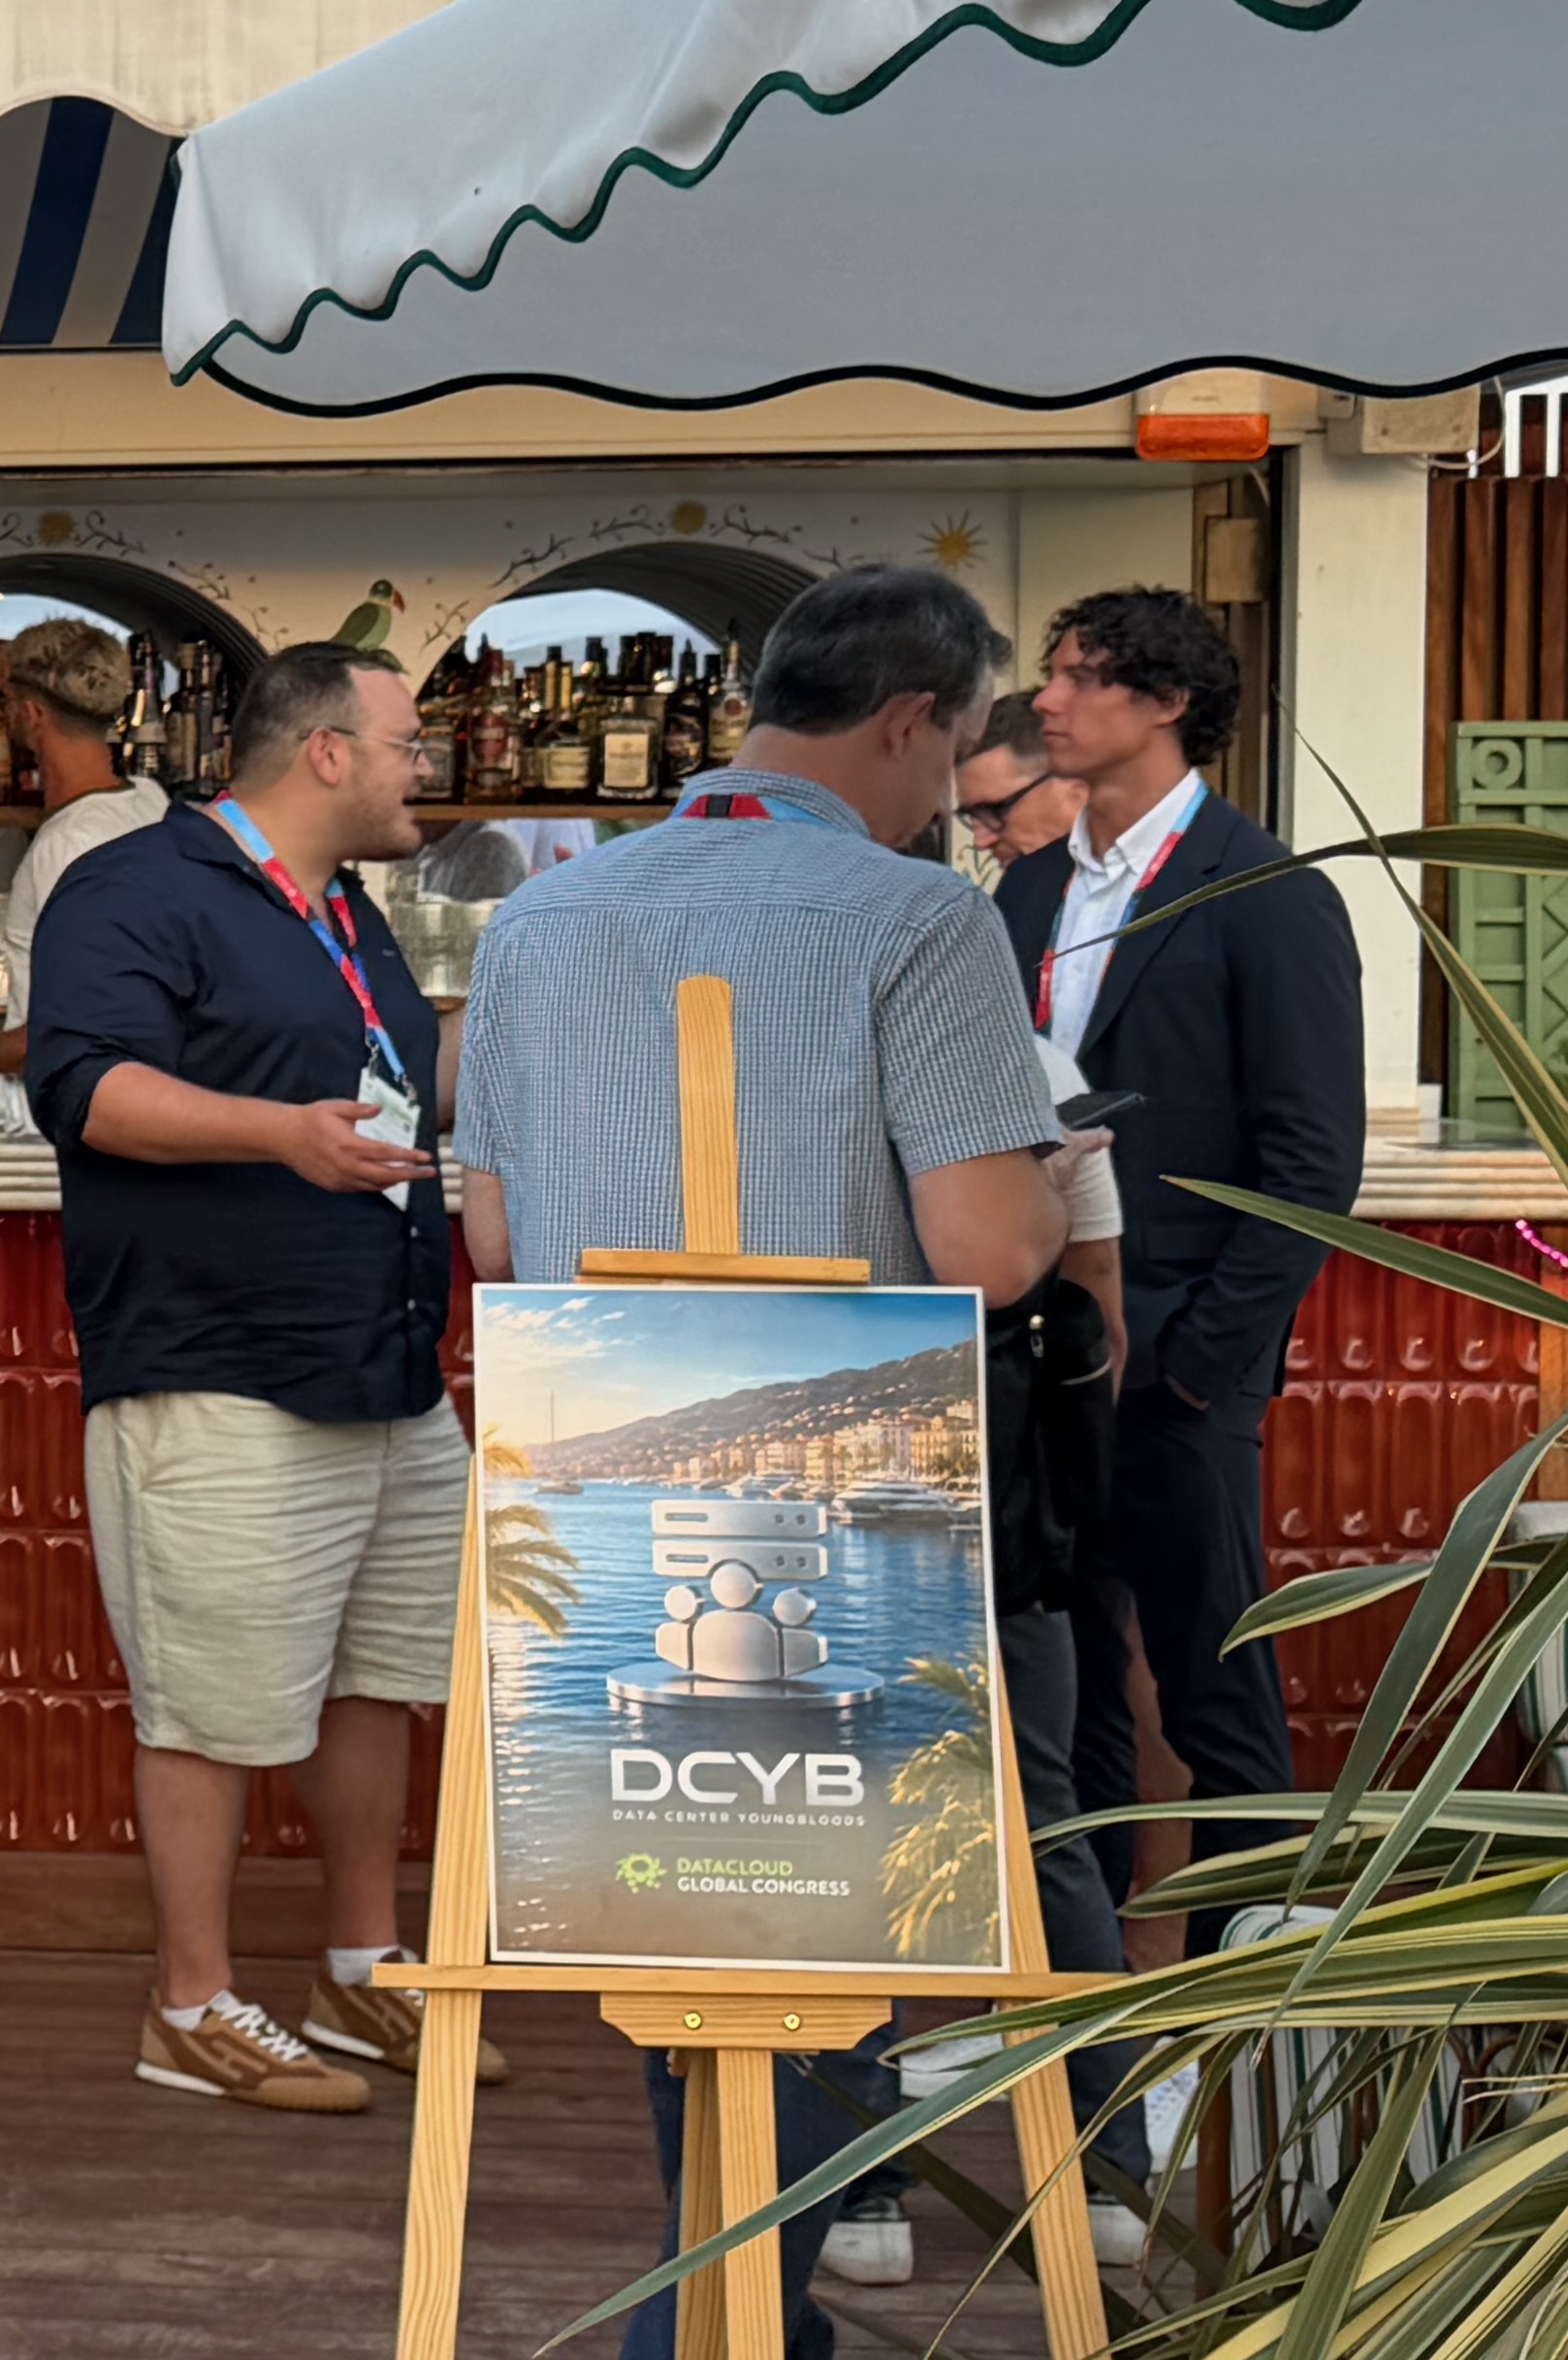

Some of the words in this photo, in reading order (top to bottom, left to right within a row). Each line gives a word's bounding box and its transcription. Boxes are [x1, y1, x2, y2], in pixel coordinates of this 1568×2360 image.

[610, 1749, 865, 1806] DCYB
[613, 1808, 656, 1821] DATA
[664, 1810, 730, 1823] CENTER
[738, 1812, 865, 1827] YOUNGBLOODS
[677, 1858, 793, 1876] DATACLOUD
[677, 1877, 748, 1892] GLOBAL
[752, 1878, 850, 1896] CONGRESS
